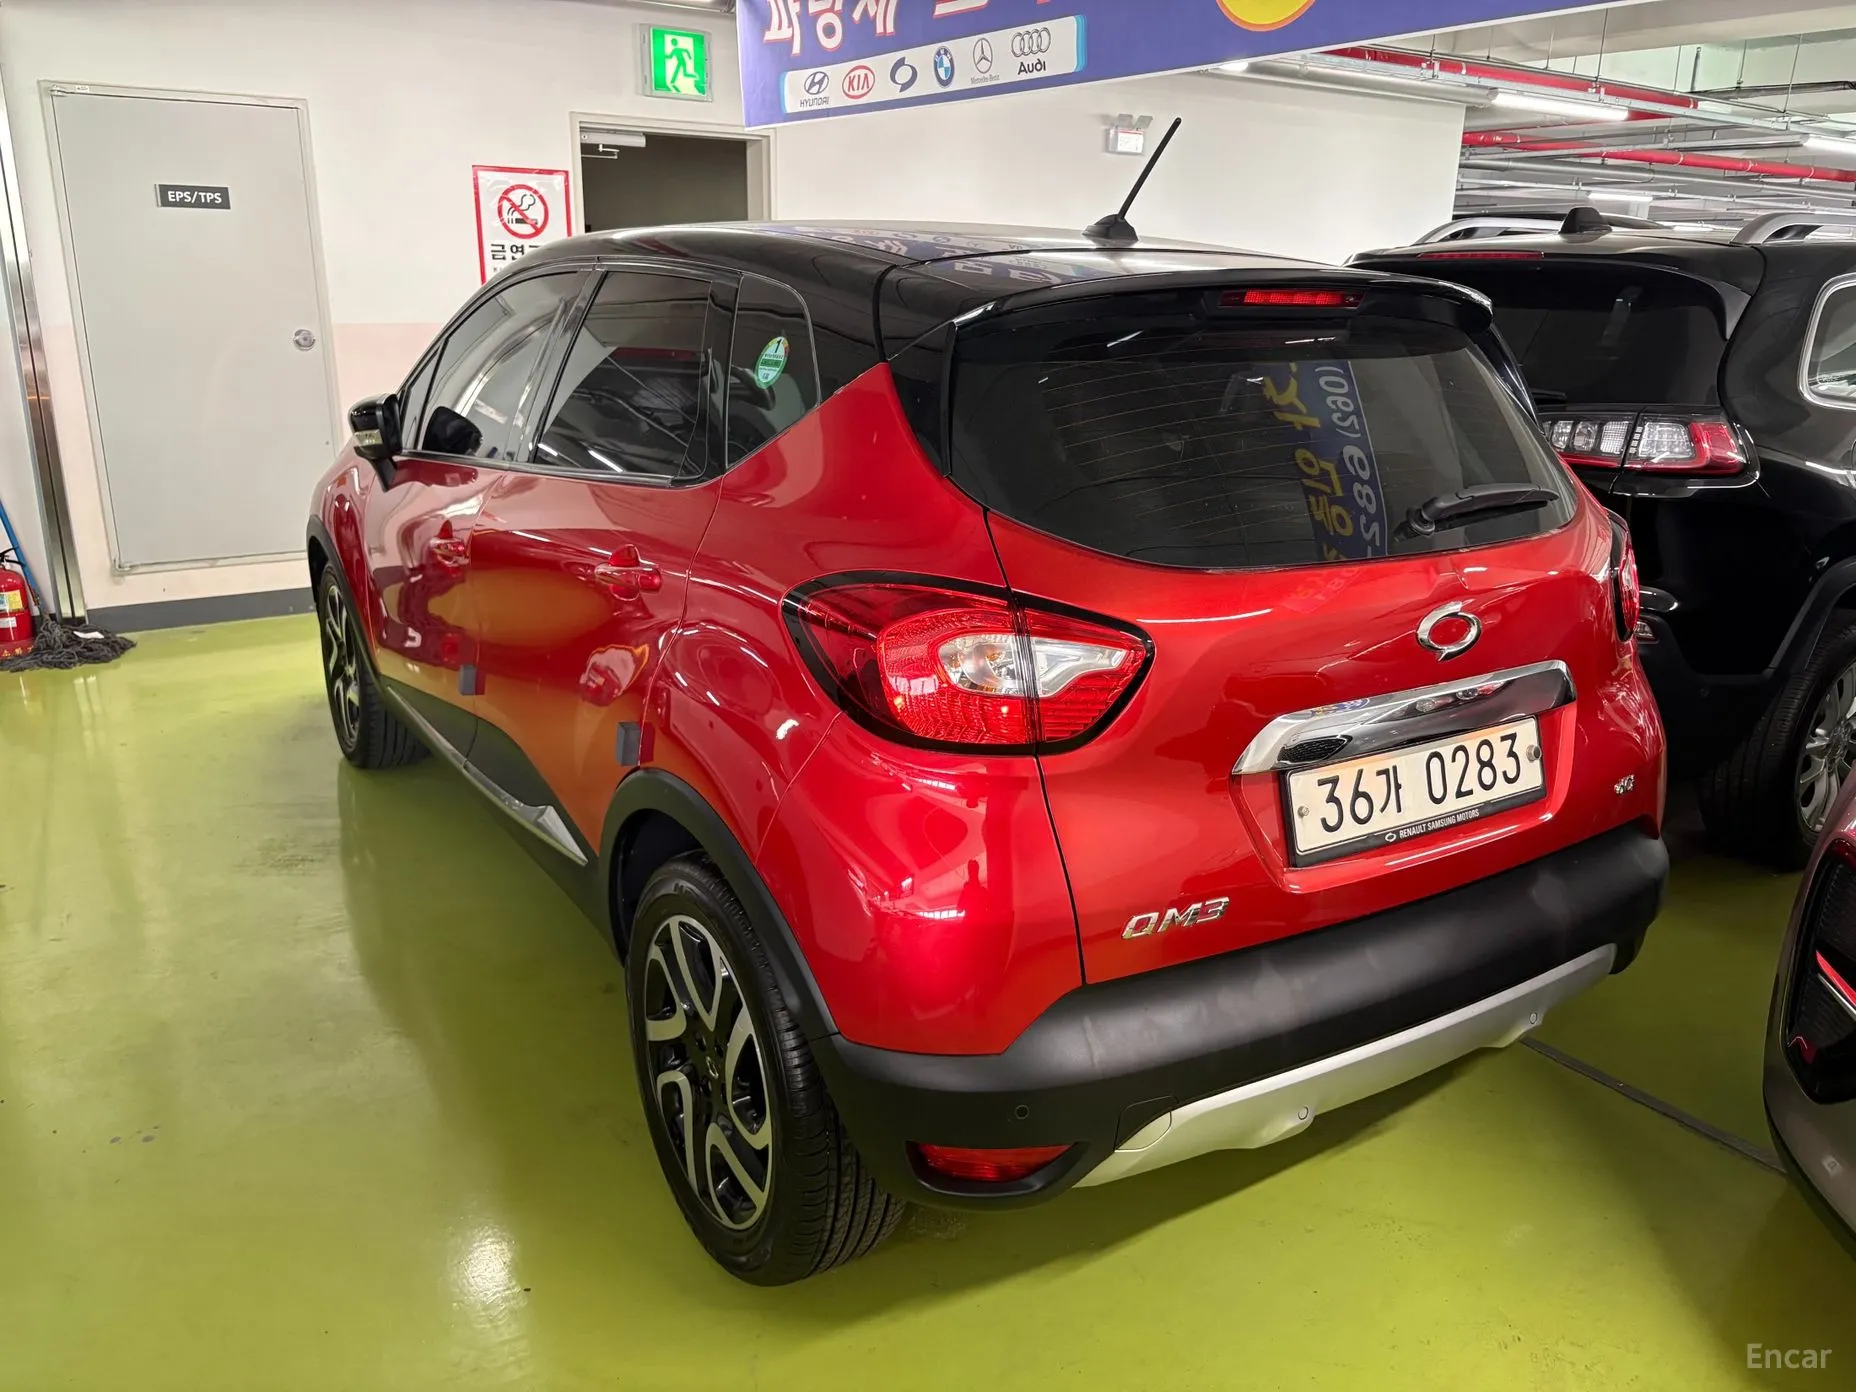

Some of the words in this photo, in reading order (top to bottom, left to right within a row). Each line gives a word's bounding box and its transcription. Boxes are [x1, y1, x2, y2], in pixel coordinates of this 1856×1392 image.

[1017, 58, 1047, 75] Audi
[848, 75, 870, 91] KIA
[800, 96, 830, 107] HYUNDAI
[168, 191, 222, 203] EPS/TPS
[491, 244, 541, 261] 금연
[1317, 765, 1402, 833] 36가
[1425, 732, 1521, 805] 0283
[1399, 825, 1426, 839] RENAULT
[1427, 816, 1456, 830] SAMSUNG
[1456, 808, 1480, 822] MOTORS
[1121, 896, 1230, 939] QM3
